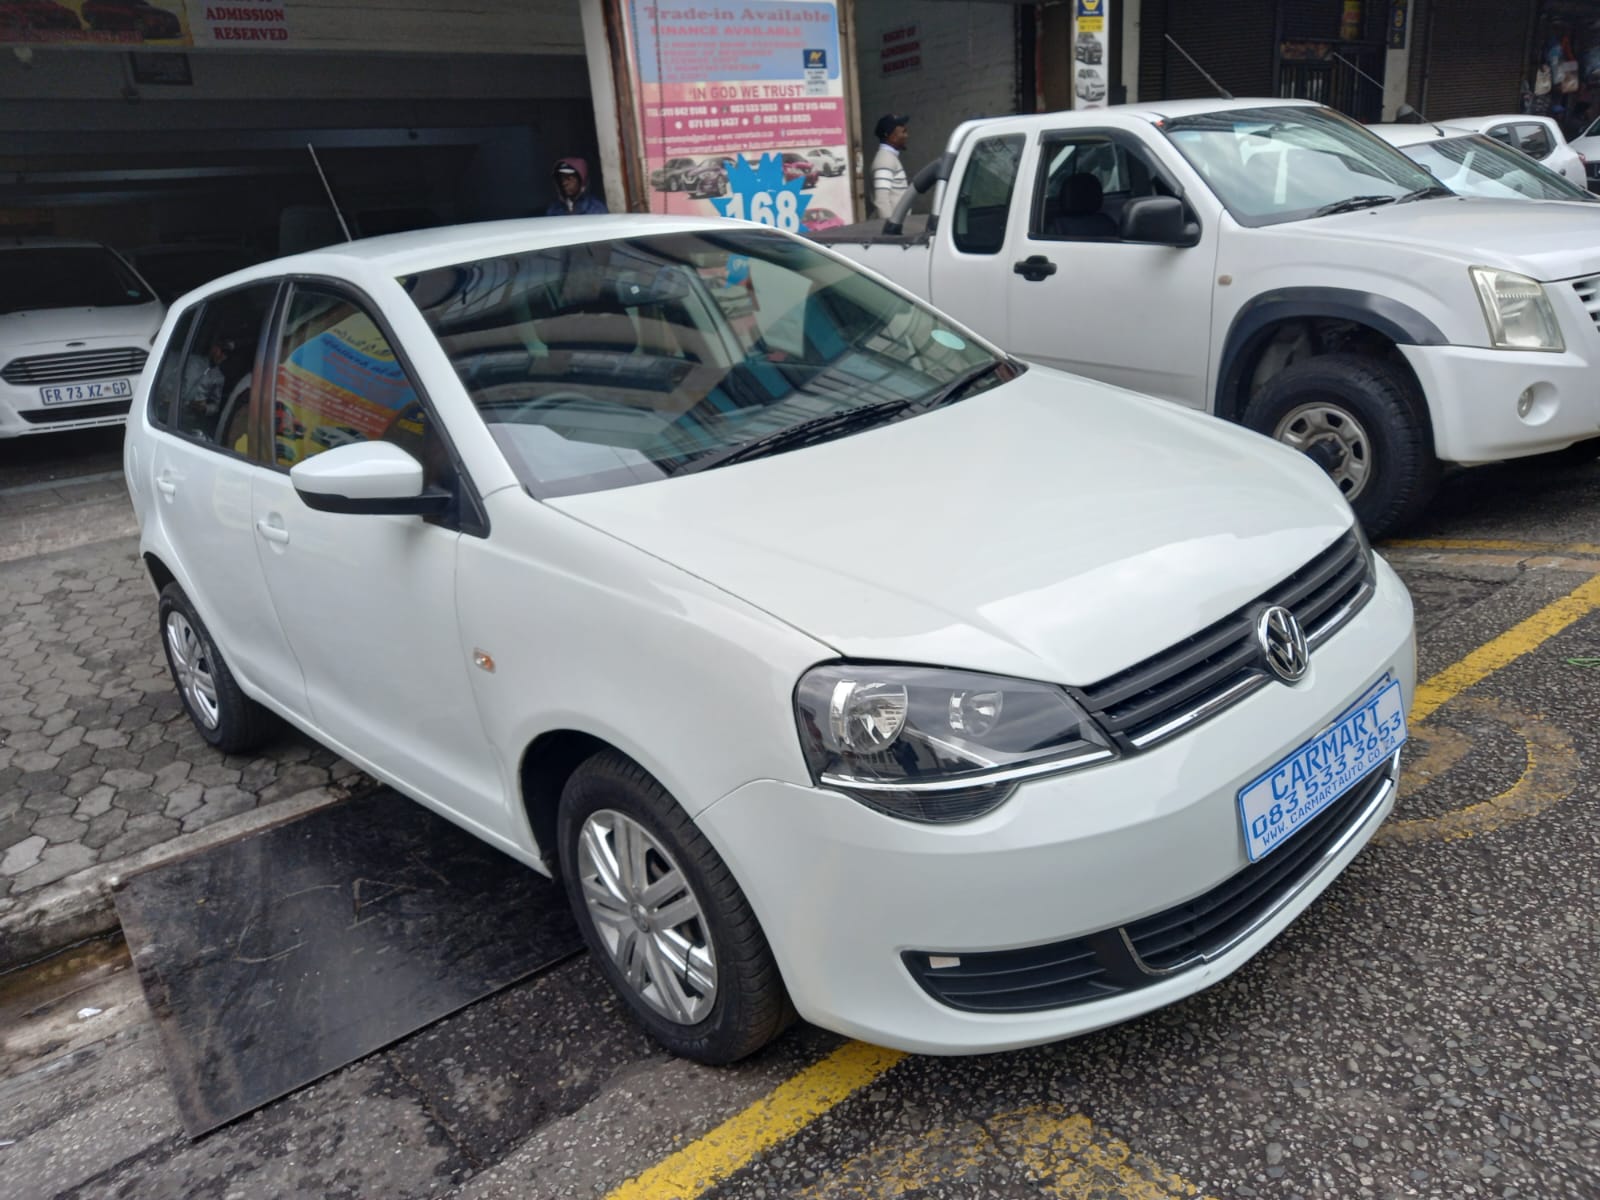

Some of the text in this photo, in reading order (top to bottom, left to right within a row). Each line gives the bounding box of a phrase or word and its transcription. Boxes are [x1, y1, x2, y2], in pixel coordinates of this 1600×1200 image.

[207, 7, 284, 21] ADMISSION
[643, 6, 830, 22] Trade-in Available
[213, 27, 288, 40] RESERVED
[724, 26, 802, 37] AVAILABLE
[711, 86, 736, 98] GOD
[741, 86, 760, 97] WE
[45, 382, 127, 402] FR 73 XZ GP
[1270, 700, 1380, 801] CARMART
[1252, 711, 1402, 839] 083 533 3653
